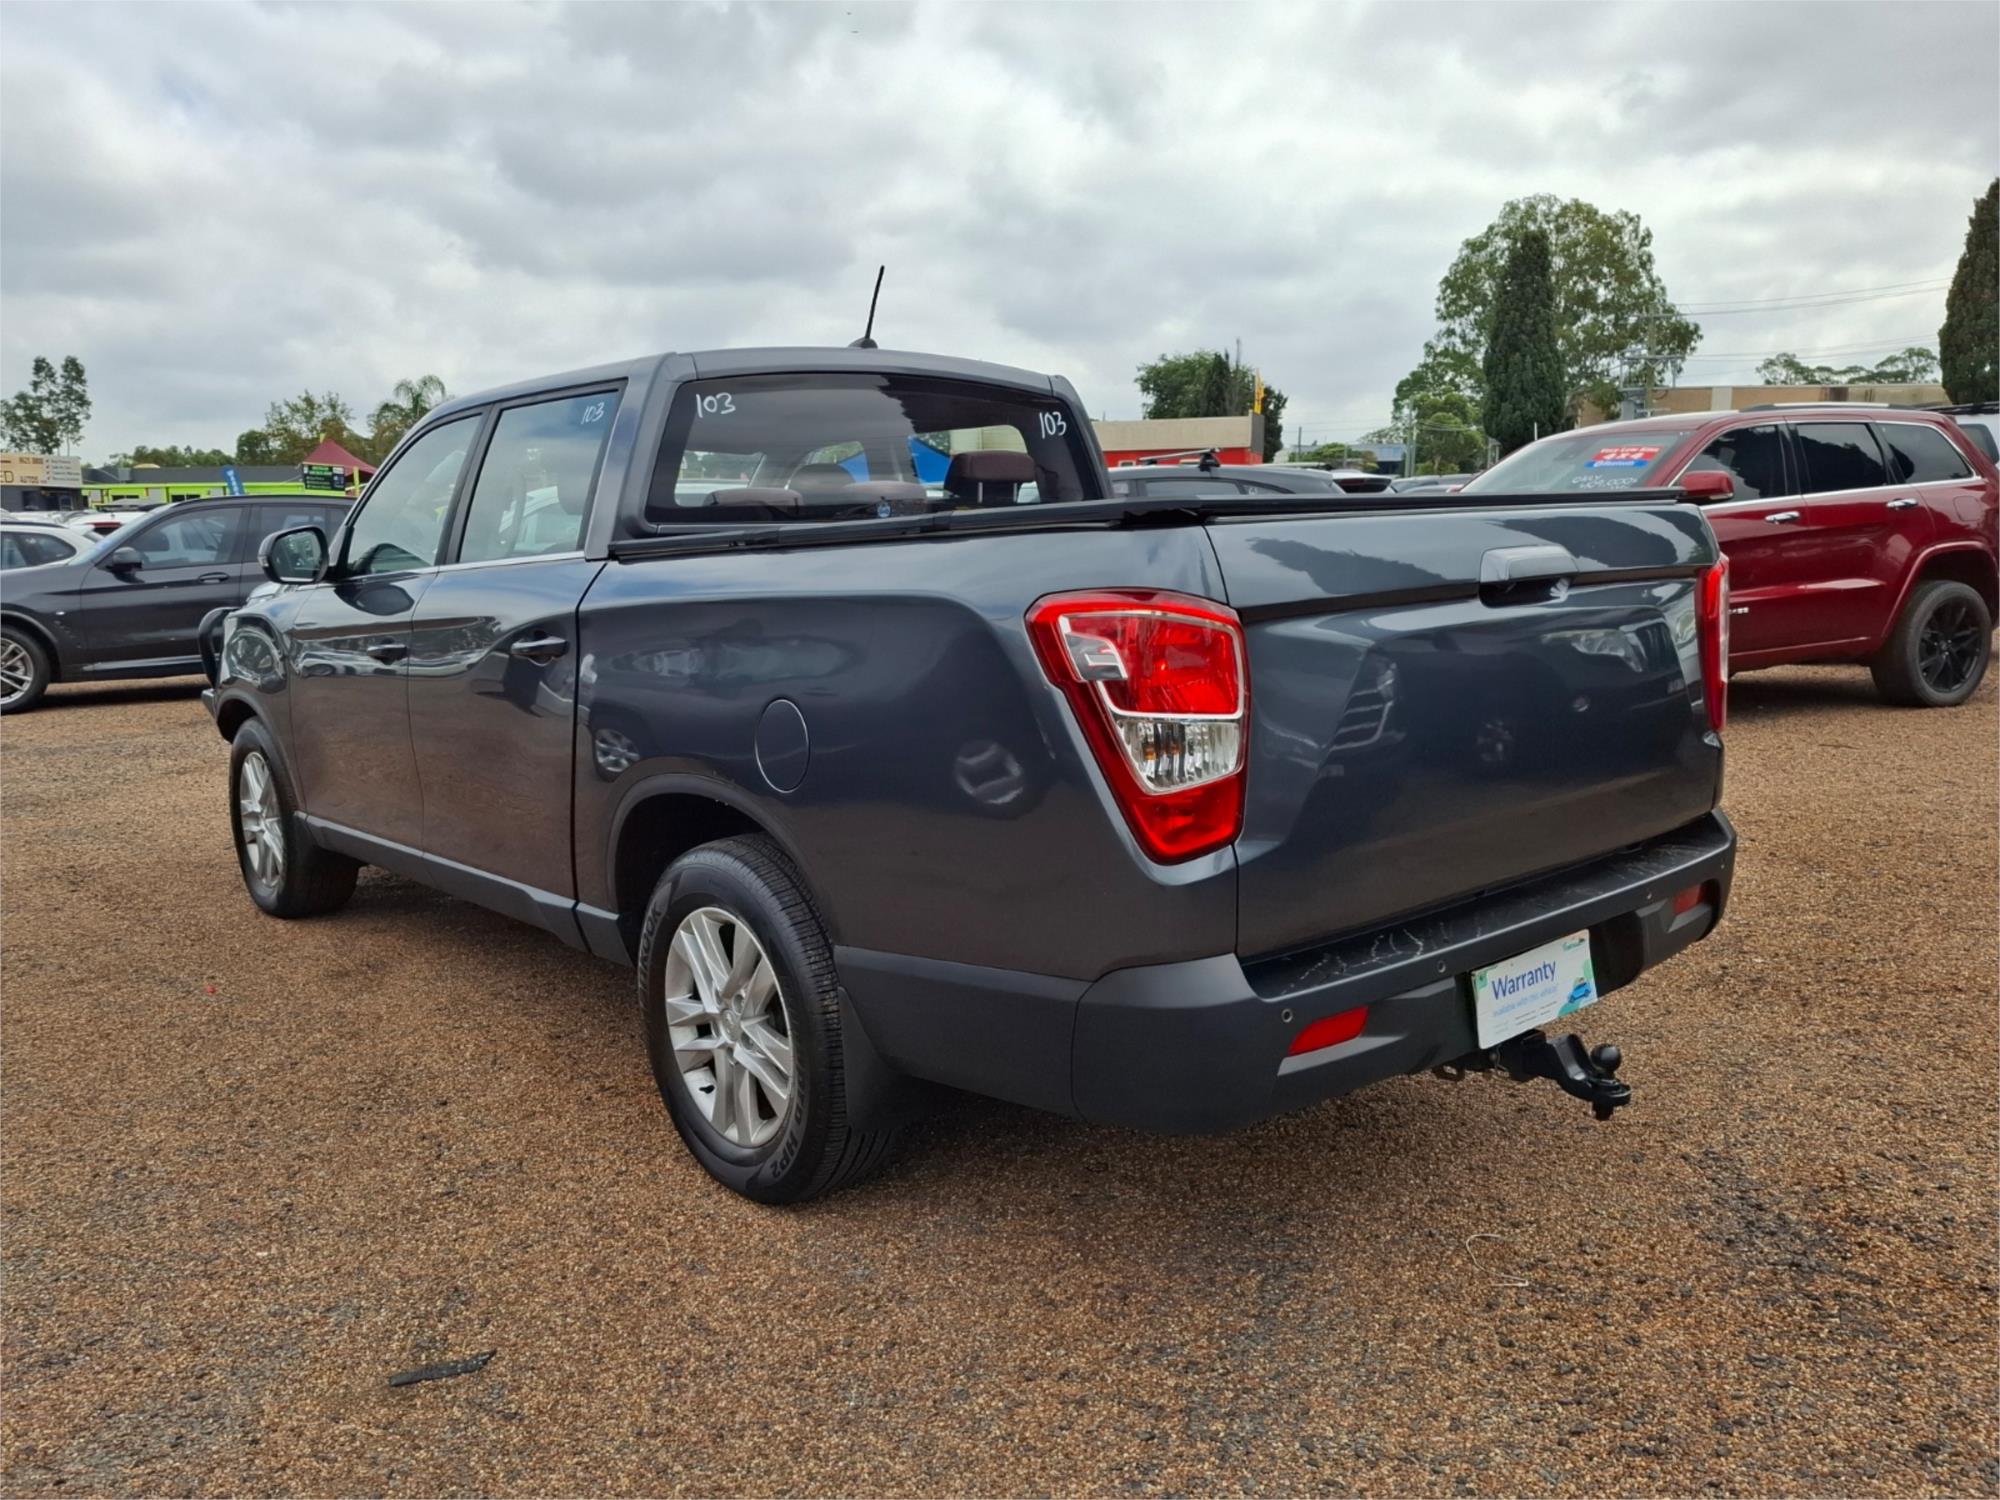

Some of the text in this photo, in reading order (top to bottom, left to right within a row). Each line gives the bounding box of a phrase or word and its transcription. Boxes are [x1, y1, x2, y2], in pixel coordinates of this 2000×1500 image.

[581, 402, 604, 425] 103
[695, 392, 736, 418] 103
[1039, 411, 1067, 439] 103
[1492, 960, 1556, 1000] Warranty
